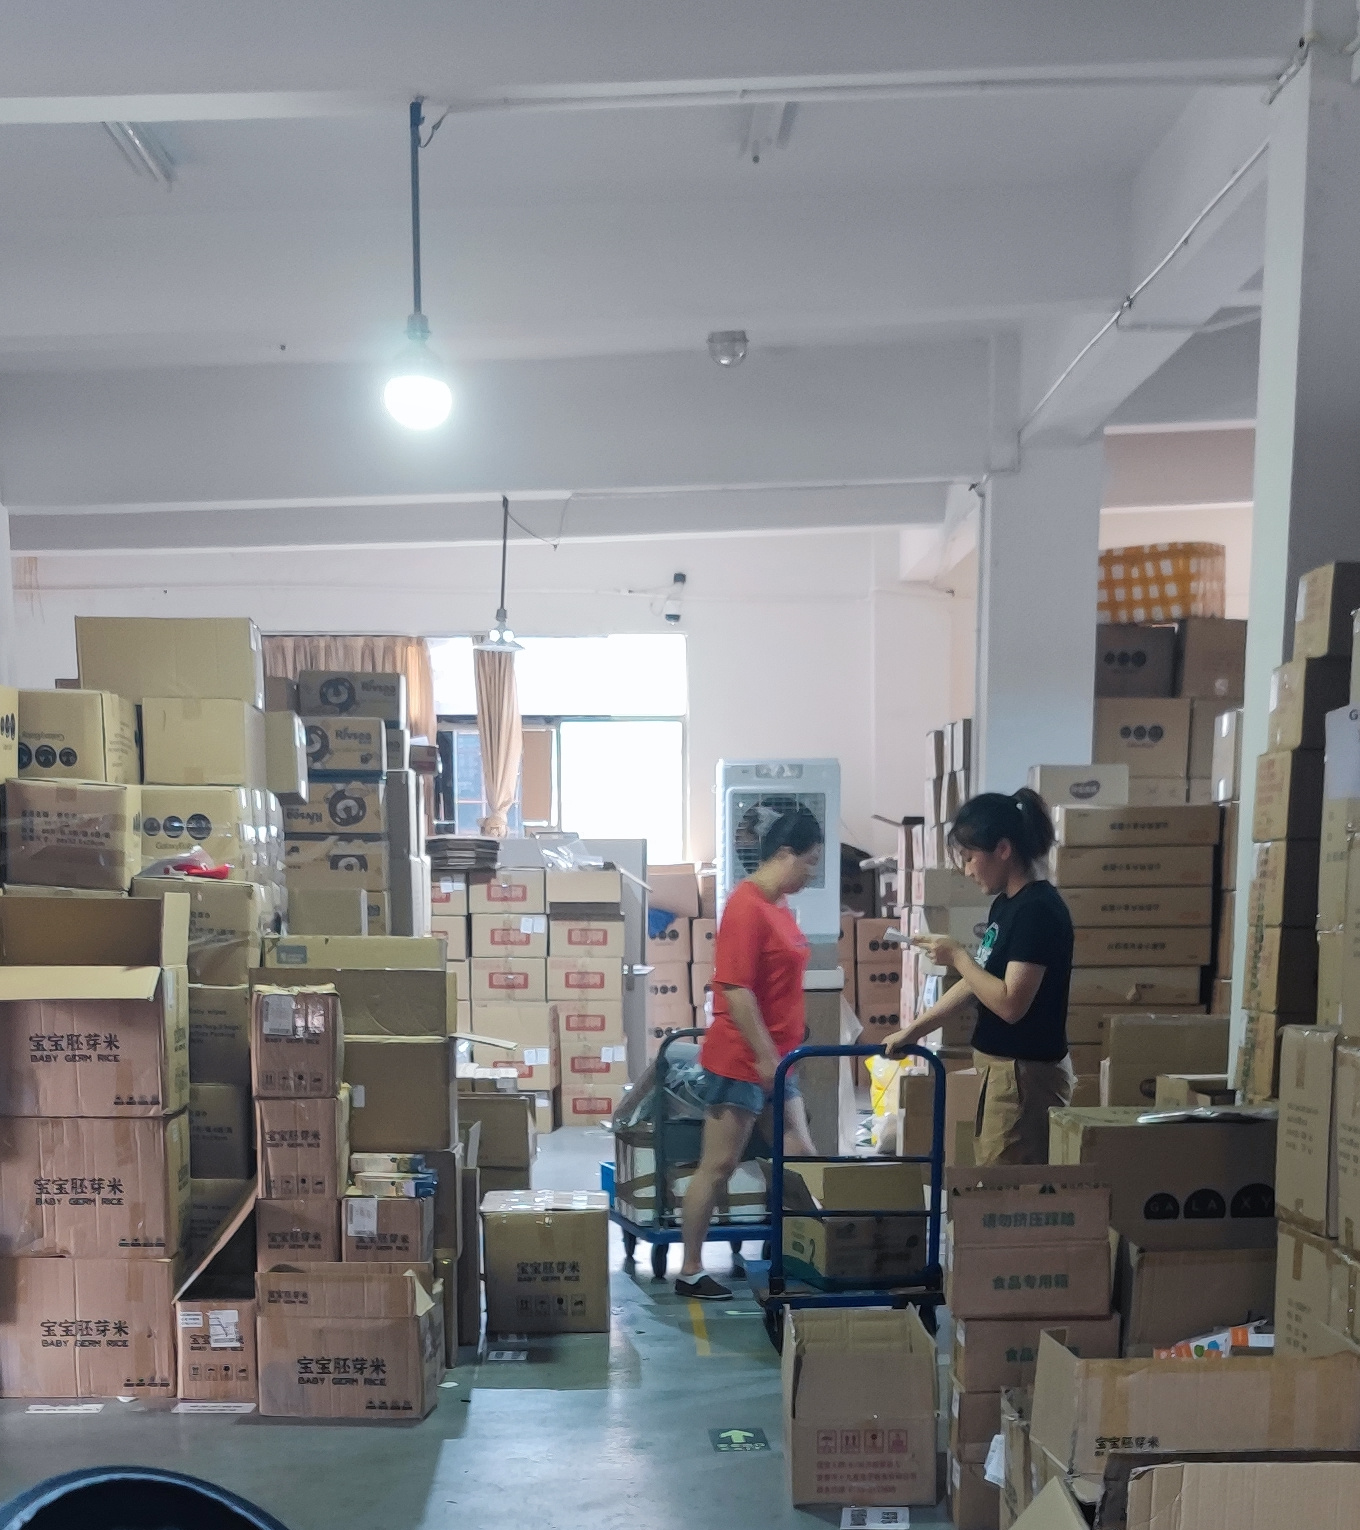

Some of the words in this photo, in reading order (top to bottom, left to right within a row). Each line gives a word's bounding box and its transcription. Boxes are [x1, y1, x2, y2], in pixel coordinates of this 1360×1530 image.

[29, 1033, 120, 1053] 宝宝胚芽米
[30, 1054, 58, 1063] BABY
[65, 1054, 92, 1063] GERM
[97, 1054, 120, 1063] RICE
[34, 1177, 125, 1197] 宝宝胚芽米
[35, 1198, 63, 1206] BABY
[68, 1198, 96, 1206] GERM
[101, 1198, 125, 1206] RICE
[40, 1320, 130, 1338] 宝宝胚芽米
[42, 1339, 69, 1348] BABY
[74, 1339, 102, 1348] GERM
[106, 1339, 129, 1348] RICE
[297, 1358, 387, 1376] 宝宝胚芽米
[298, 1376, 325, 1386] BABY
[332, 1376, 358, 1386] GERM
[364, 1376, 387, 1386] RICE
